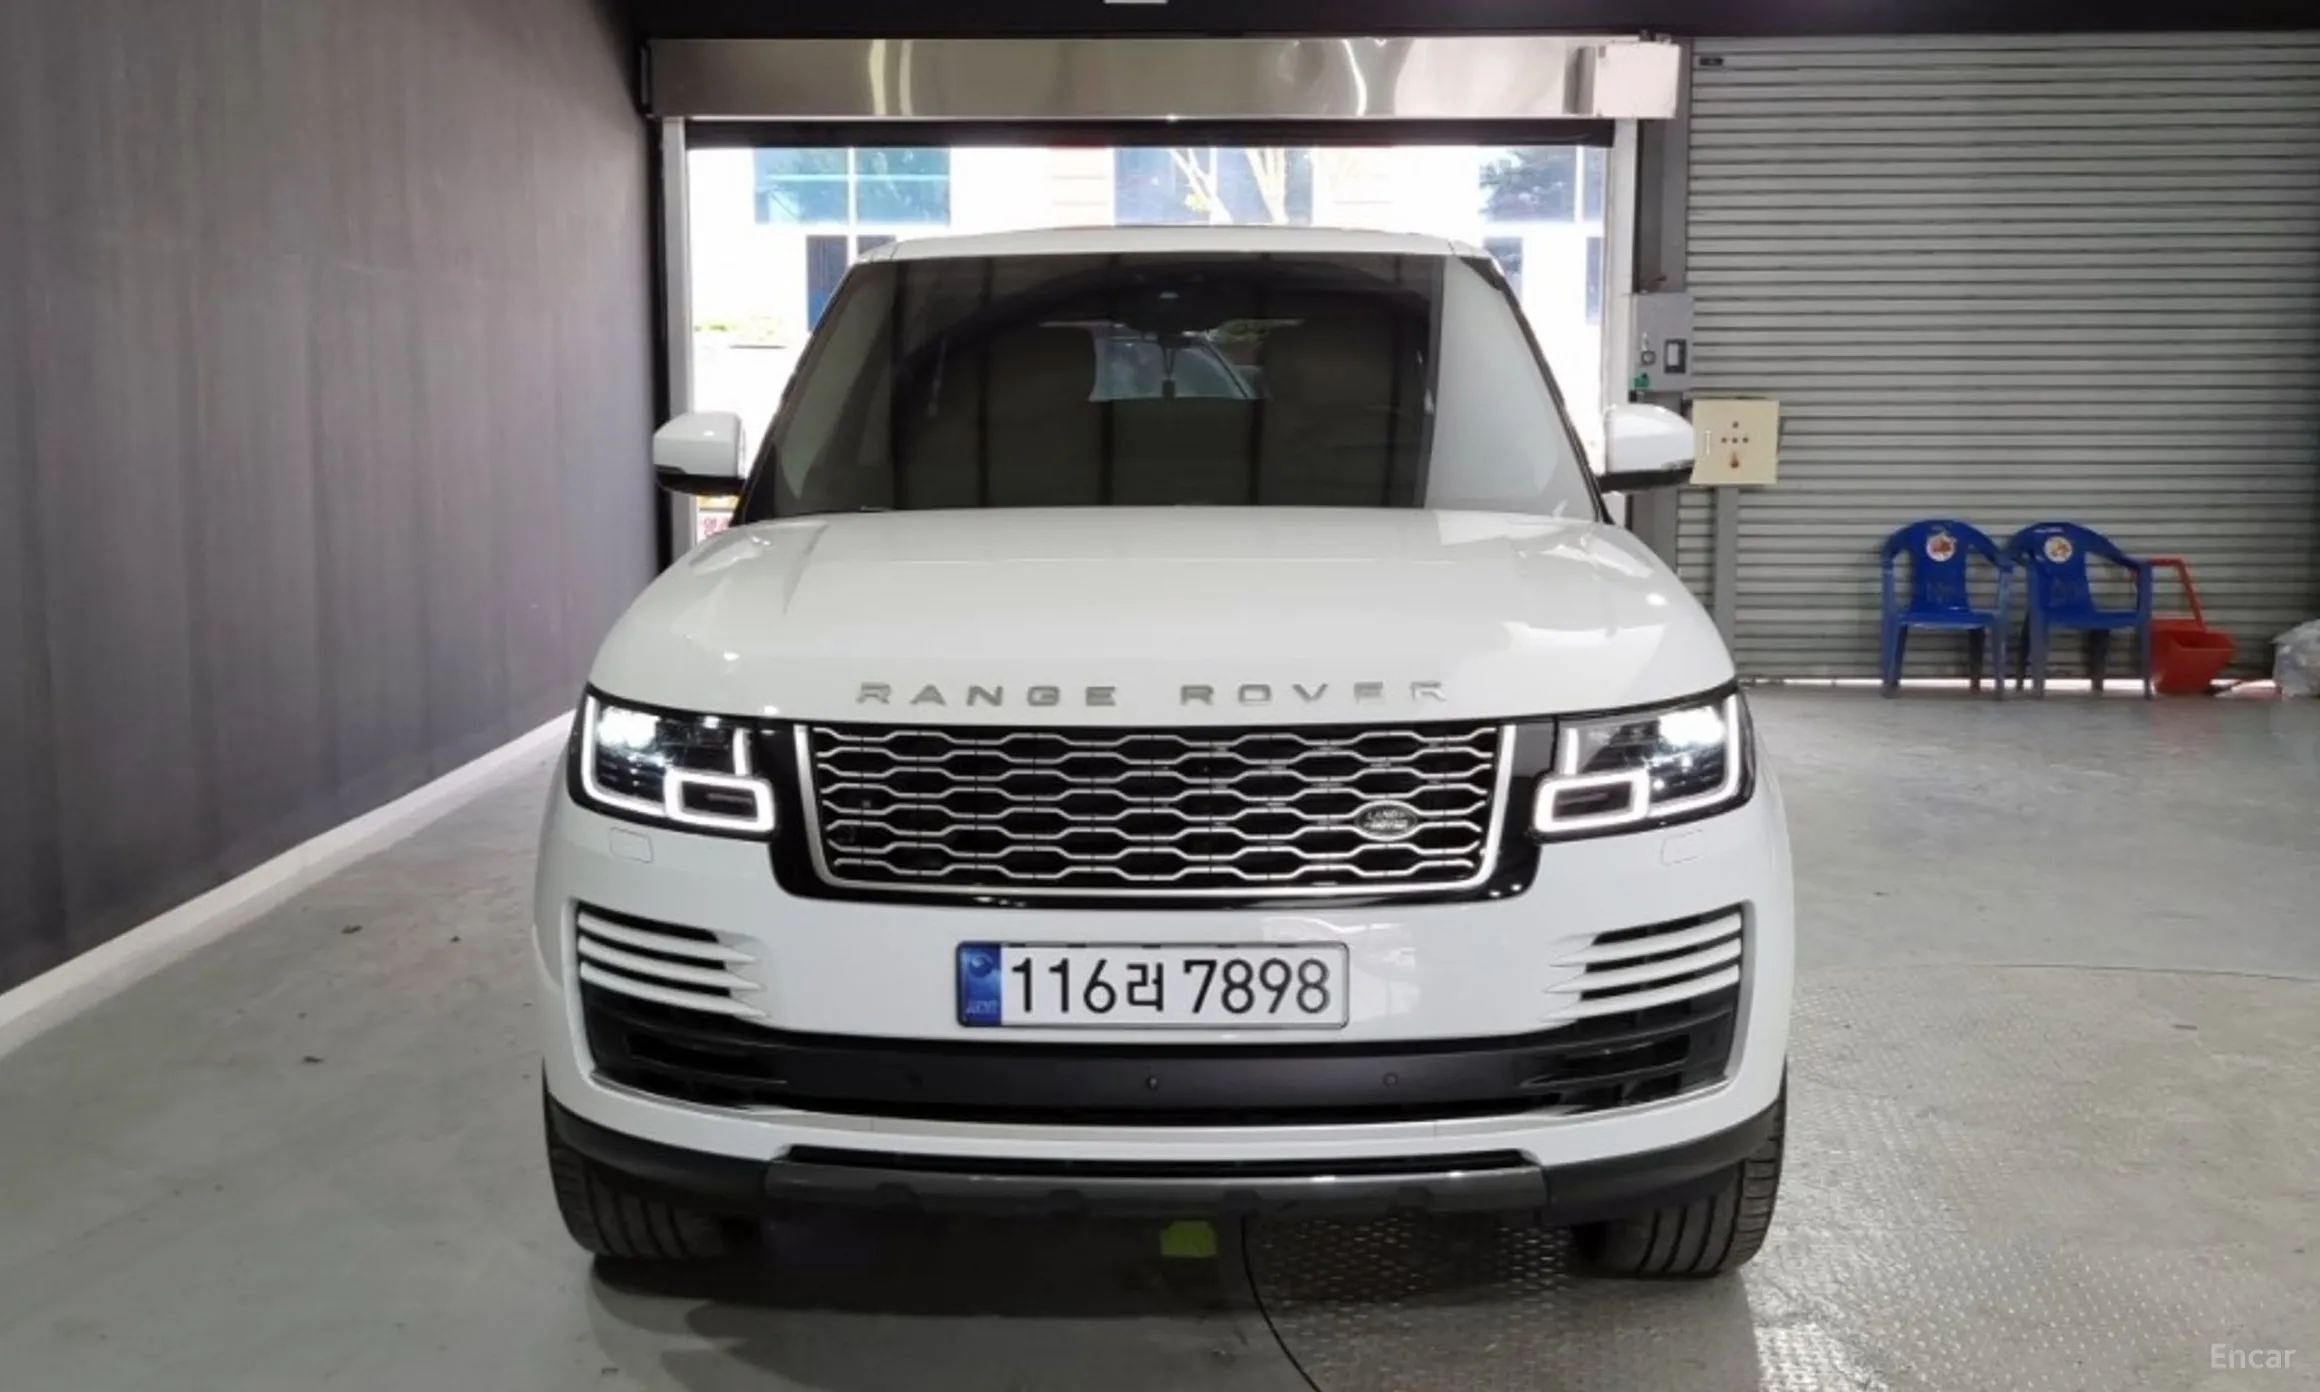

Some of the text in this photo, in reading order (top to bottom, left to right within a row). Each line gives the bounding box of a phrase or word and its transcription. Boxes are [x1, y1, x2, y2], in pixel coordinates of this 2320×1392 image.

[855, 680, 1447, 707] RANGE ROVER
[1010, 957, 1331, 1014] 116러 7898
